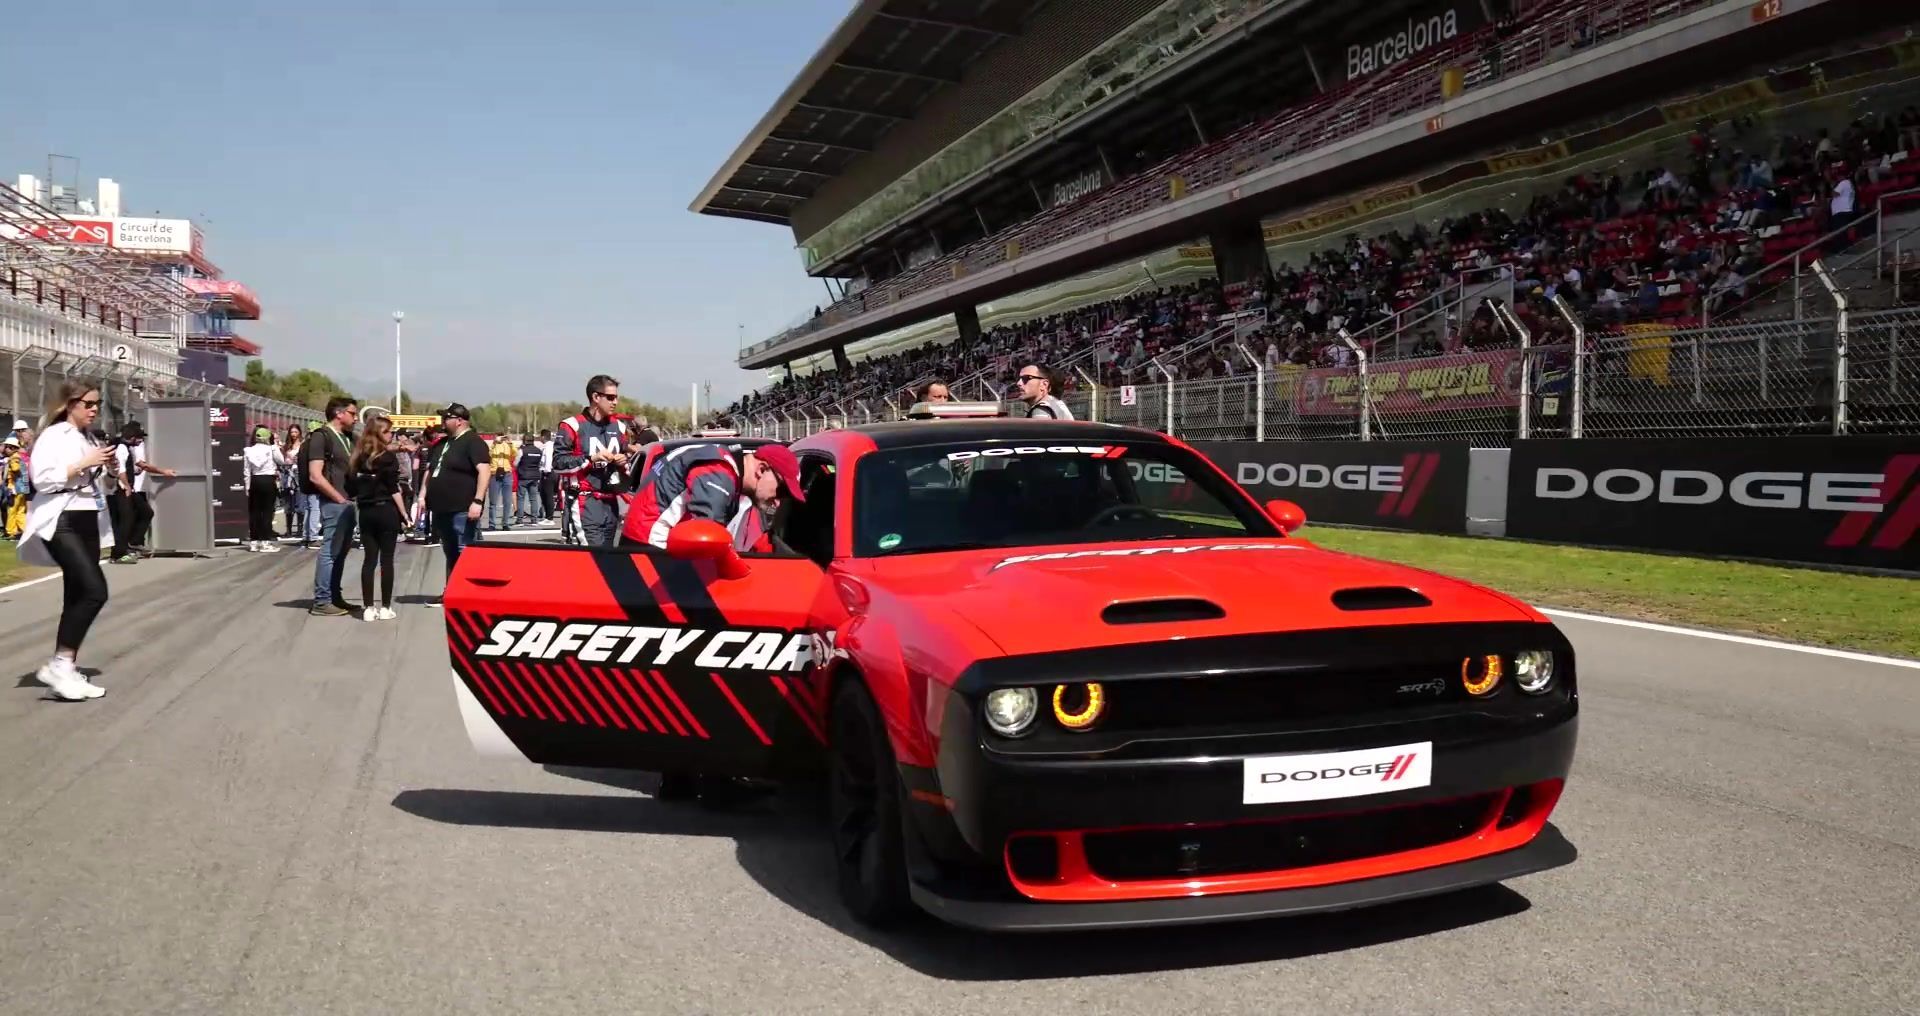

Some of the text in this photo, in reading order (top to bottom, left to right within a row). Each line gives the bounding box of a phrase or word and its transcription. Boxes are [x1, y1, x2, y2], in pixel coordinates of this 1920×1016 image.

[1346, 8, 1458, 81] Barcelona
[1053, 170, 1102, 206] Barcelona
[119, 233, 173, 244] Barcelona
[120, 222, 173, 233] Circuit de
[116, 346, 127, 360] 2
[947, 445, 1108, 461] DODGE
[1237, 462, 1405, 493] DODGE
[1535, 467, 1886, 513] DODGE
[475, 619, 704, 666] SAFETY
[1395, 682, 1436, 693] SRT
[1260, 761, 1397, 784] DODGE
